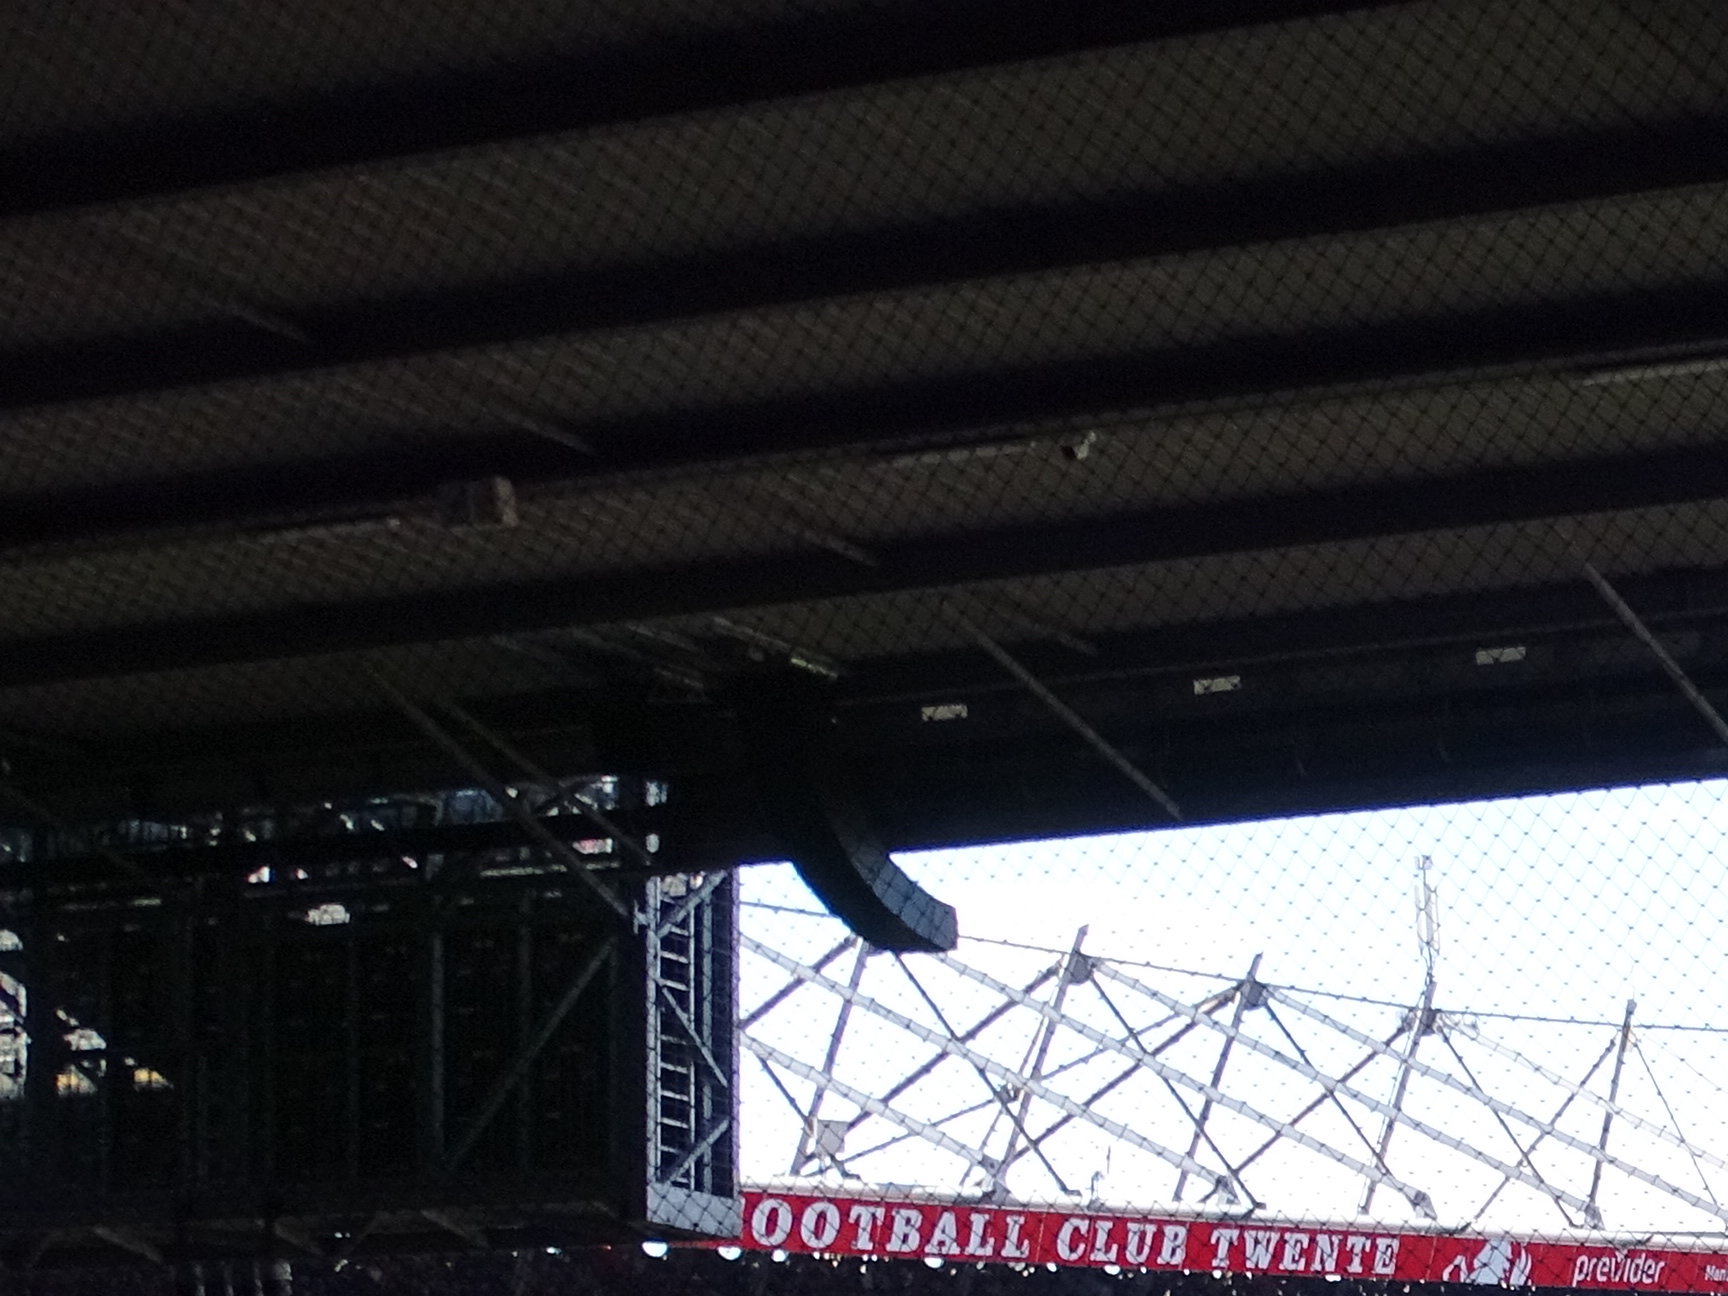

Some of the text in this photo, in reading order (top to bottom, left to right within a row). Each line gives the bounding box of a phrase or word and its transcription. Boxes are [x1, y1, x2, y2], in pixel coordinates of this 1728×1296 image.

[1057, 1217, 1186, 1265] CLUB
[1210, 1229, 1400, 1275] TWENTE
[1573, 1250, 1667, 1285] previder
